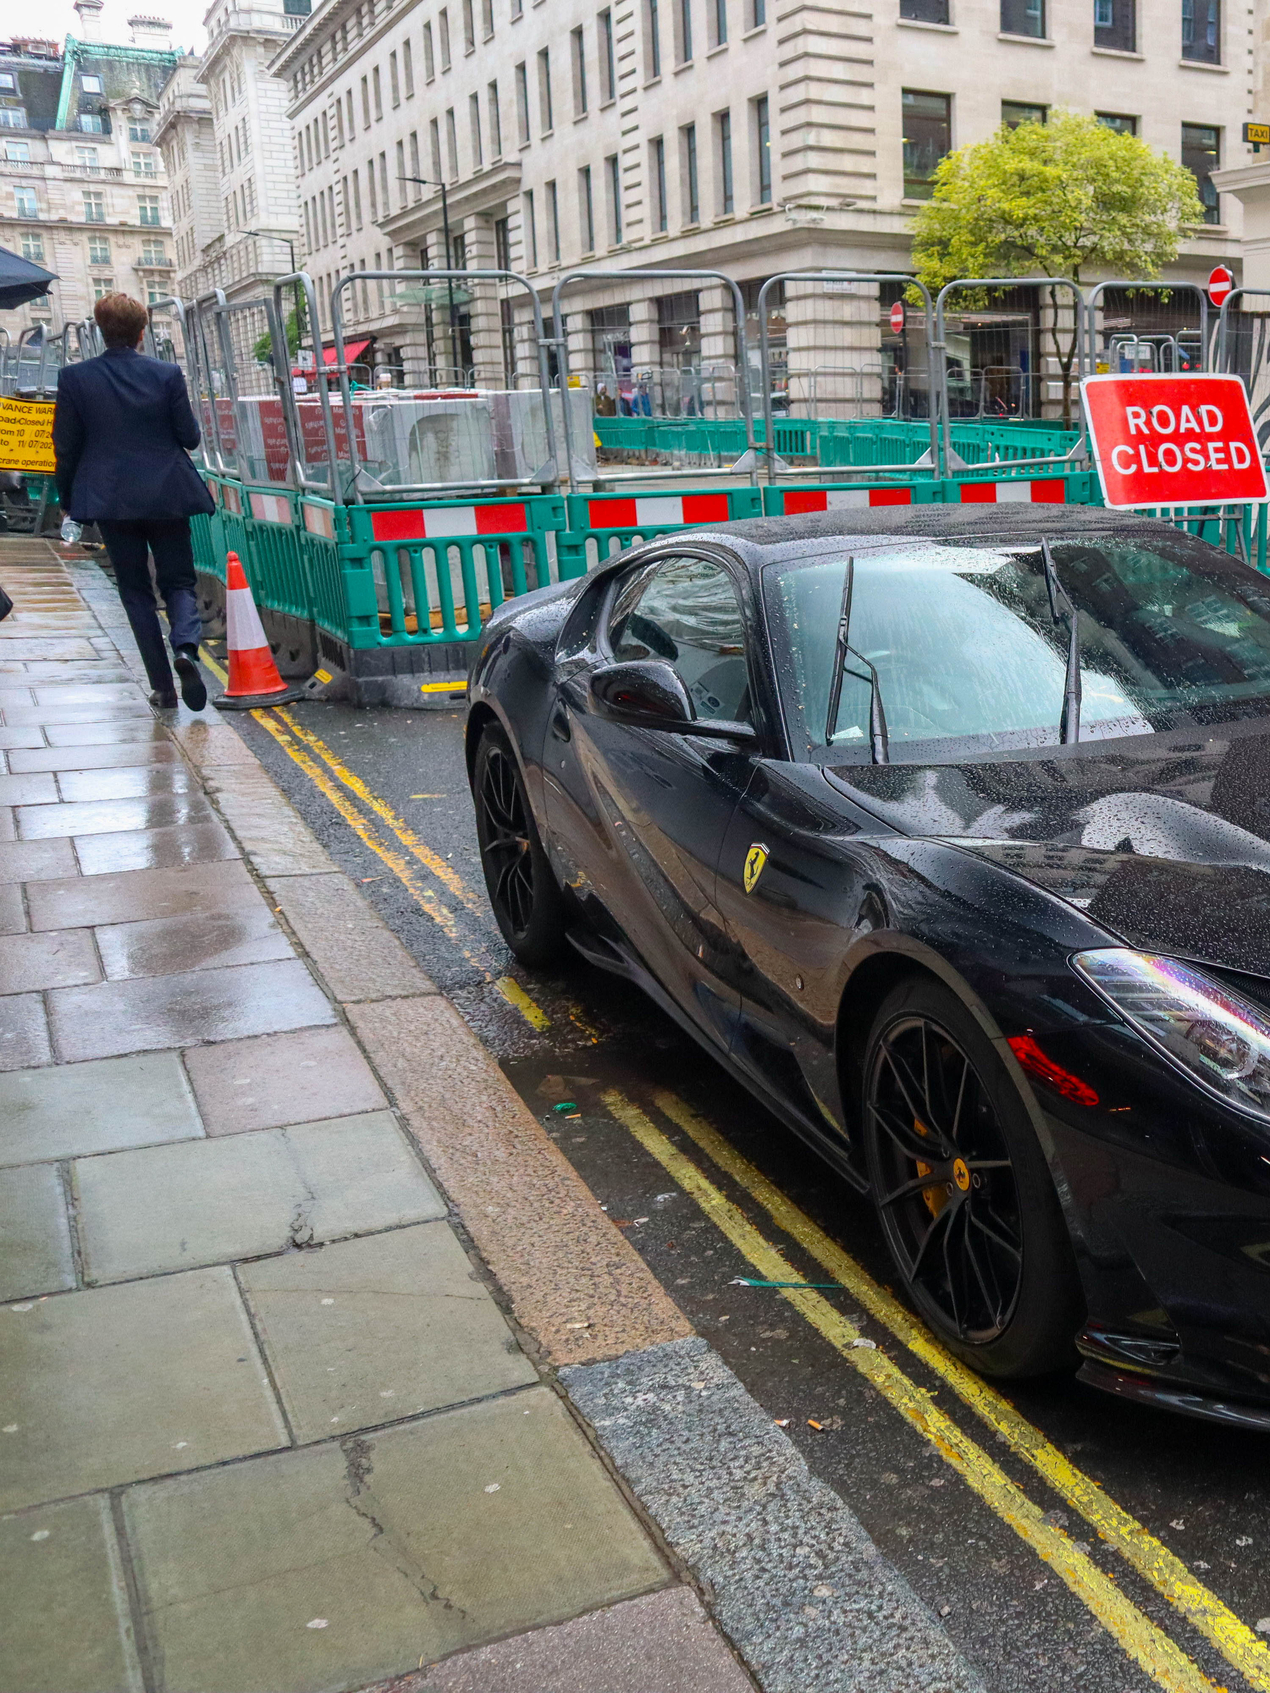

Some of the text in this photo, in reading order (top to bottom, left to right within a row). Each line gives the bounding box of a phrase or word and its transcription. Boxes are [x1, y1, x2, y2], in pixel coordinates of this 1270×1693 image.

[1249, 128, 1268, 138] TAXI
[0, 402, 33, 414] VANCE
[0, 416, 16, 424] oad
[1126, 405, 1223, 435] ROAD
[1111, 442, 1251, 475] CLOSED
